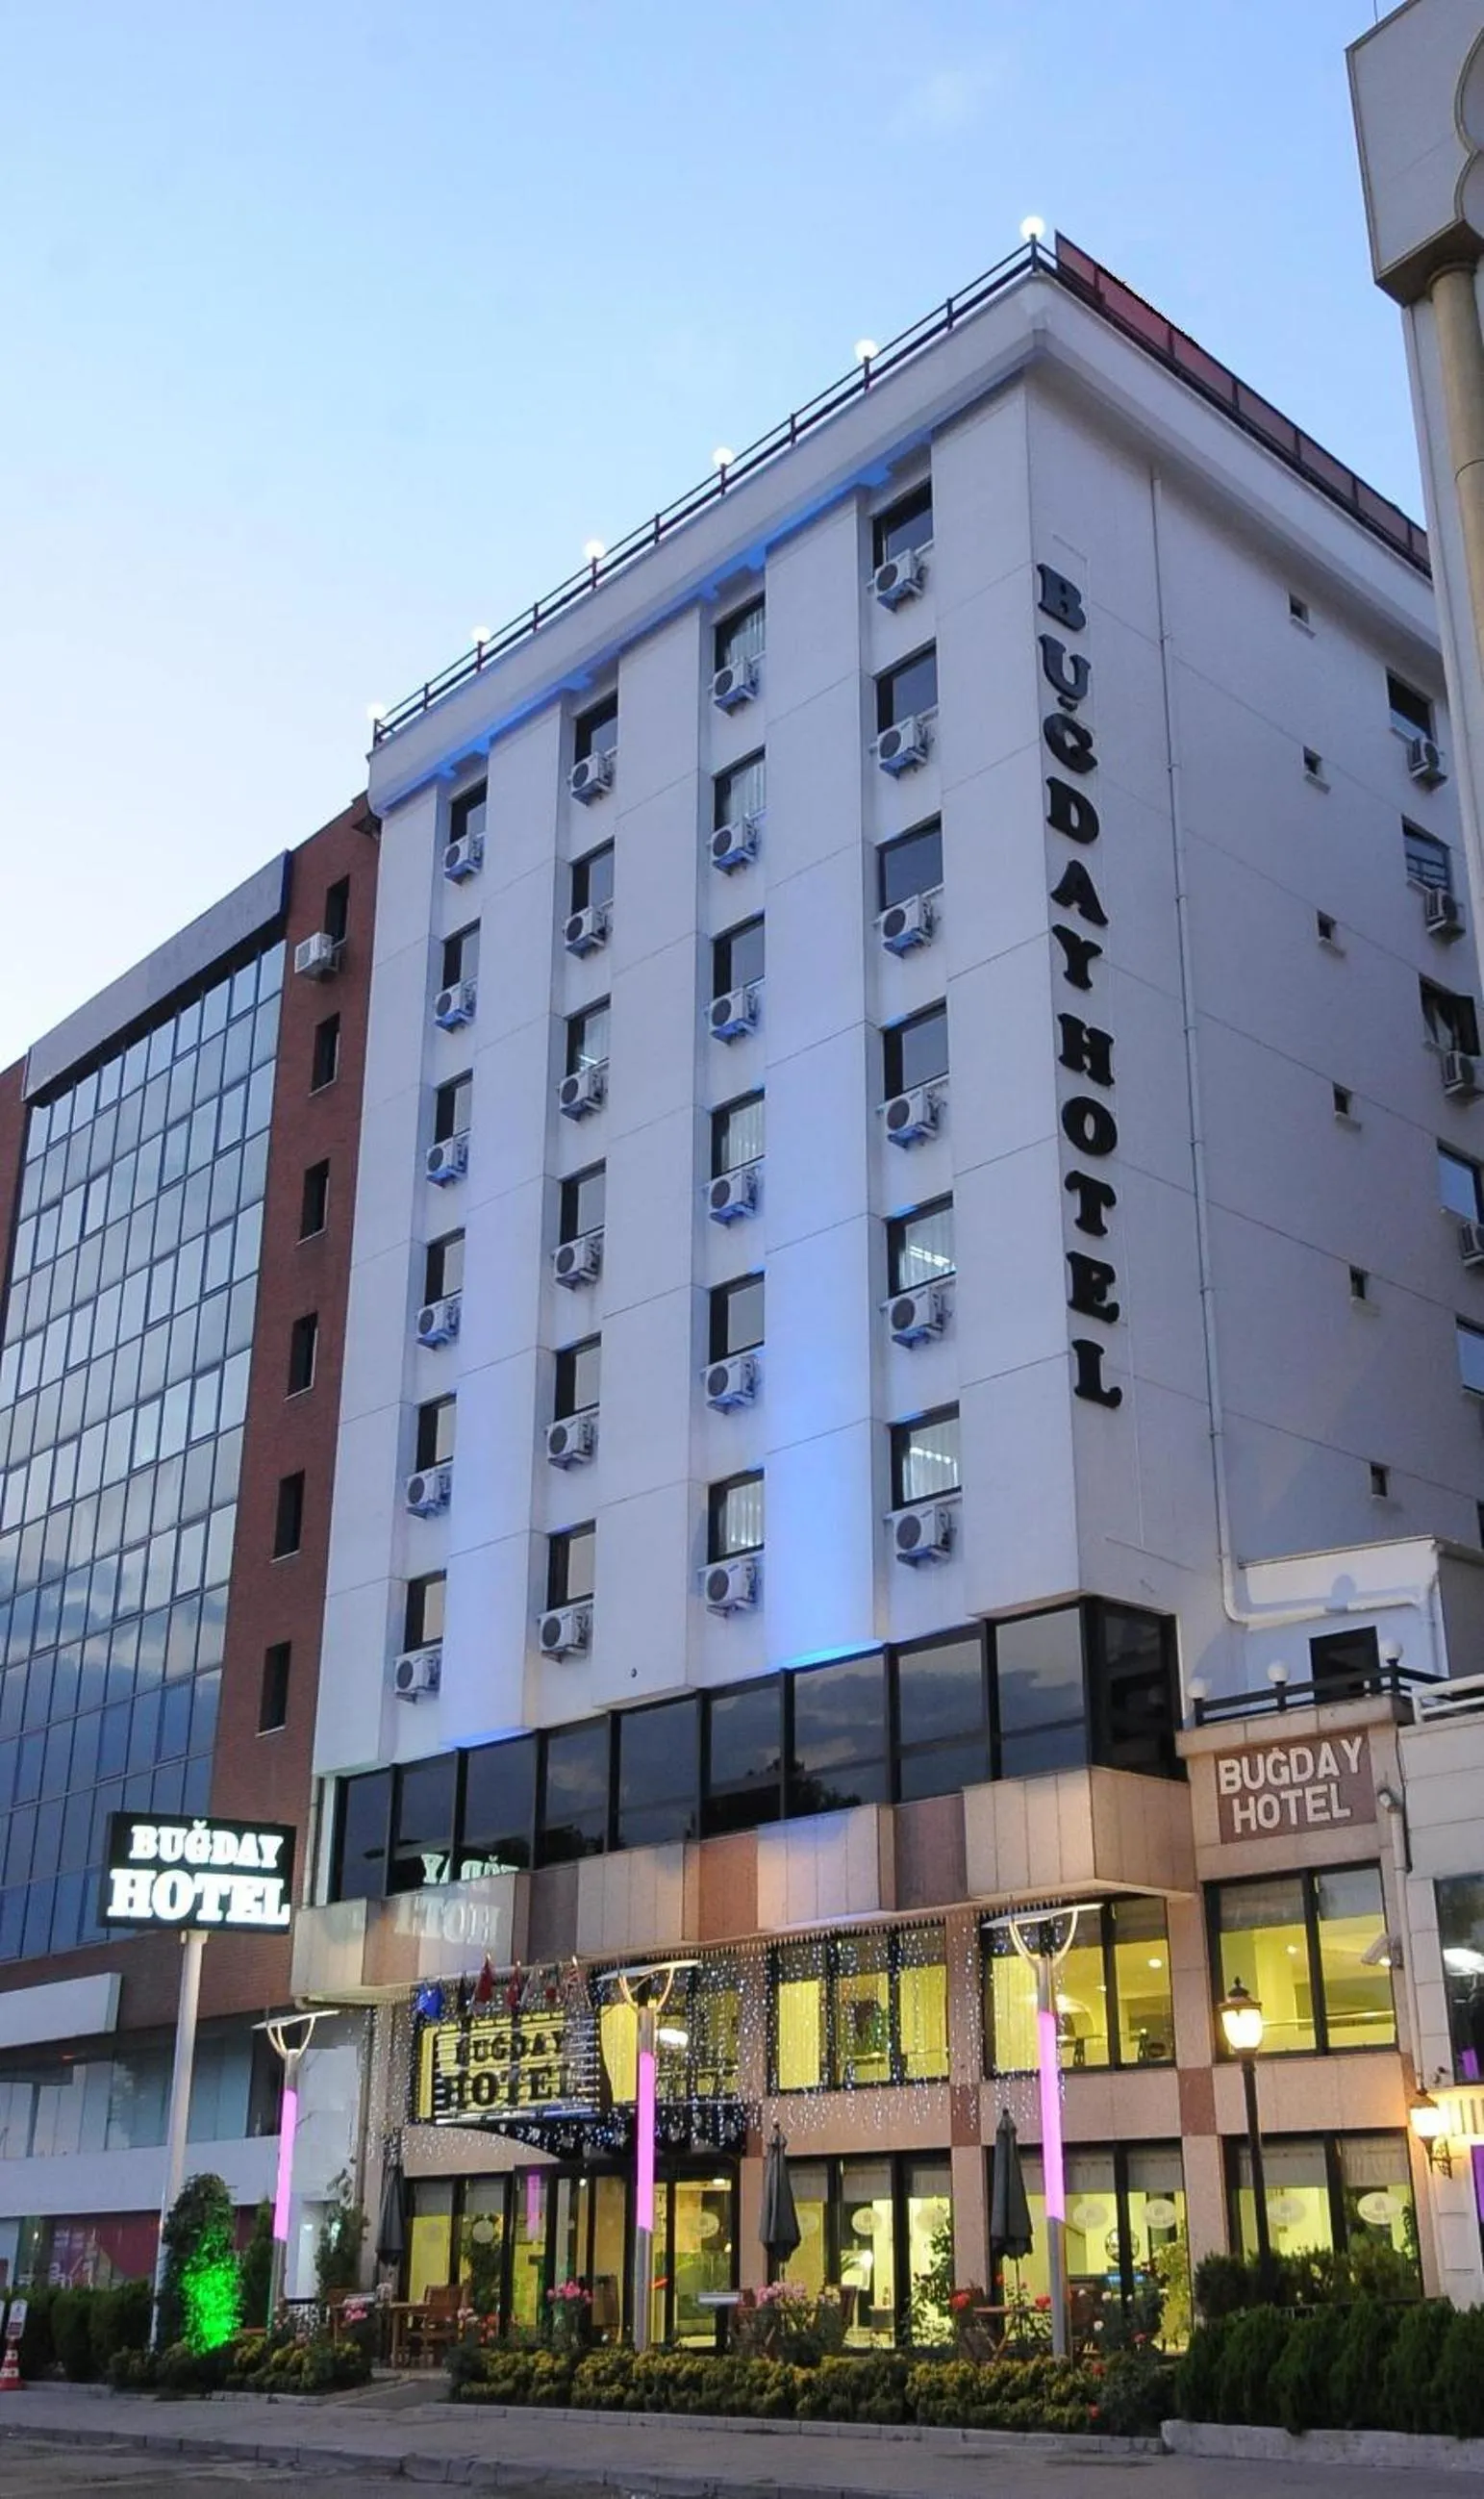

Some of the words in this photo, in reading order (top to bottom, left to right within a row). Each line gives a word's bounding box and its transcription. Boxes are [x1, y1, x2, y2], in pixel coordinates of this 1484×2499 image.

[1037, 564, 1108, 990] BUĞDAY
[1058, 1013, 1122, 1409] HOTEL
[1218, 1736, 1363, 1795] BUĞDAY
[1232, 1781, 1351, 1833] HOTEL
[129, 1819, 284, 1868] BUĞDAY
[107, 1868, 290, 1925] HOTEL
